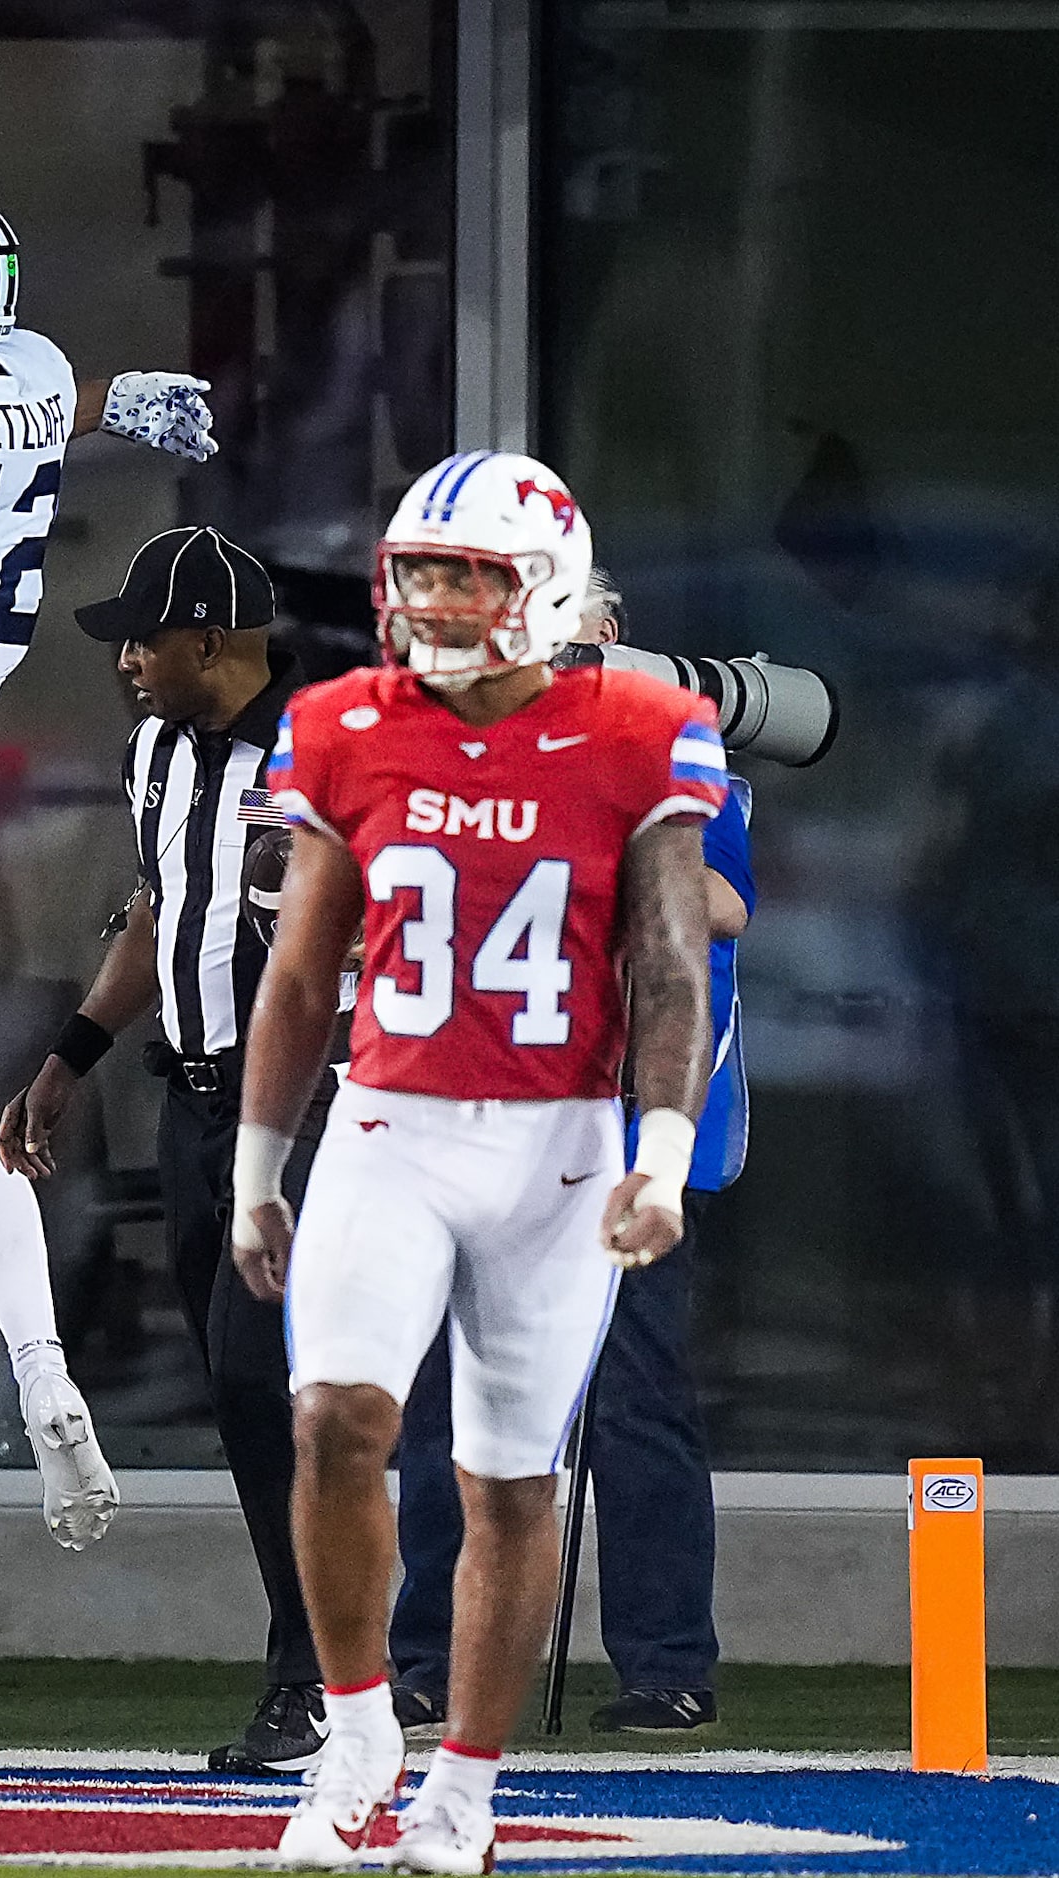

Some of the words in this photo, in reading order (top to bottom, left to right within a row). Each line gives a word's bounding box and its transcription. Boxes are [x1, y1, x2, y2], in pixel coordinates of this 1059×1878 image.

[193, 602, 207, 619] S
[144, 781, 163, 809] S
[406, 788, 539, 842] SMU
[367, 844, 572, 1047] 34
[932, 1486, 966, 1496] ACC
